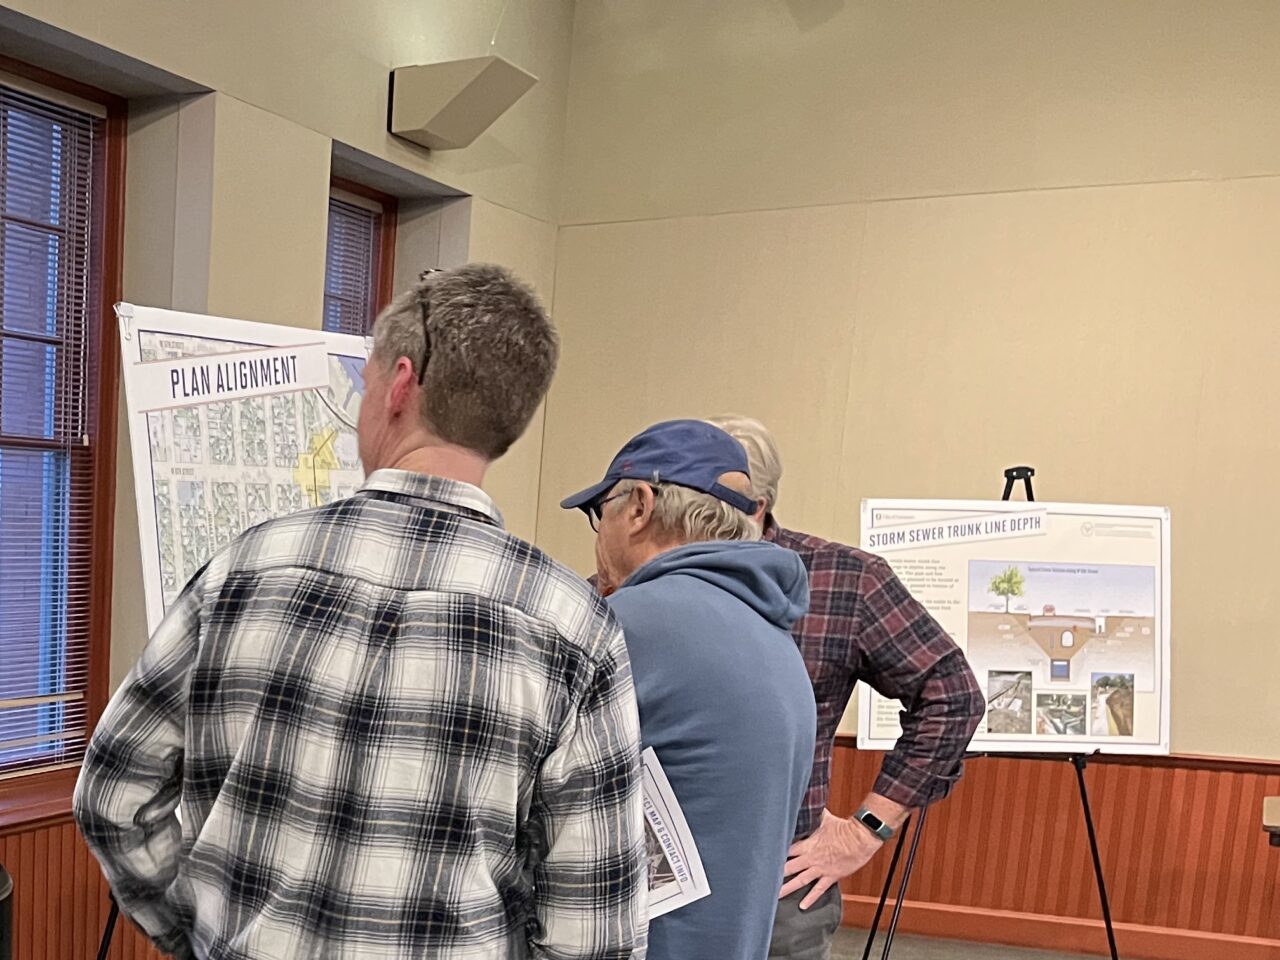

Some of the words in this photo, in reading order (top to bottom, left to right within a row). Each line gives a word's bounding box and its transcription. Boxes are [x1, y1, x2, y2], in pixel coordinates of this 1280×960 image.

[170, 365, 210, 399] PLAN
[216, 355, 297, 393] ALIGNMENT
[869, 531, 906, 547] STORM
[909, 525, 944, 542] SEWER
[947, 522, 982, 538] TRUNK
[984, 519, 1007, 534] LINE
[1010, 516, 1041, 531] DEPTH
[649, 810, 662, 826] MAP
[660, 833, 680, 865] CONTACT
[675, 863, 689, 883] INFO
